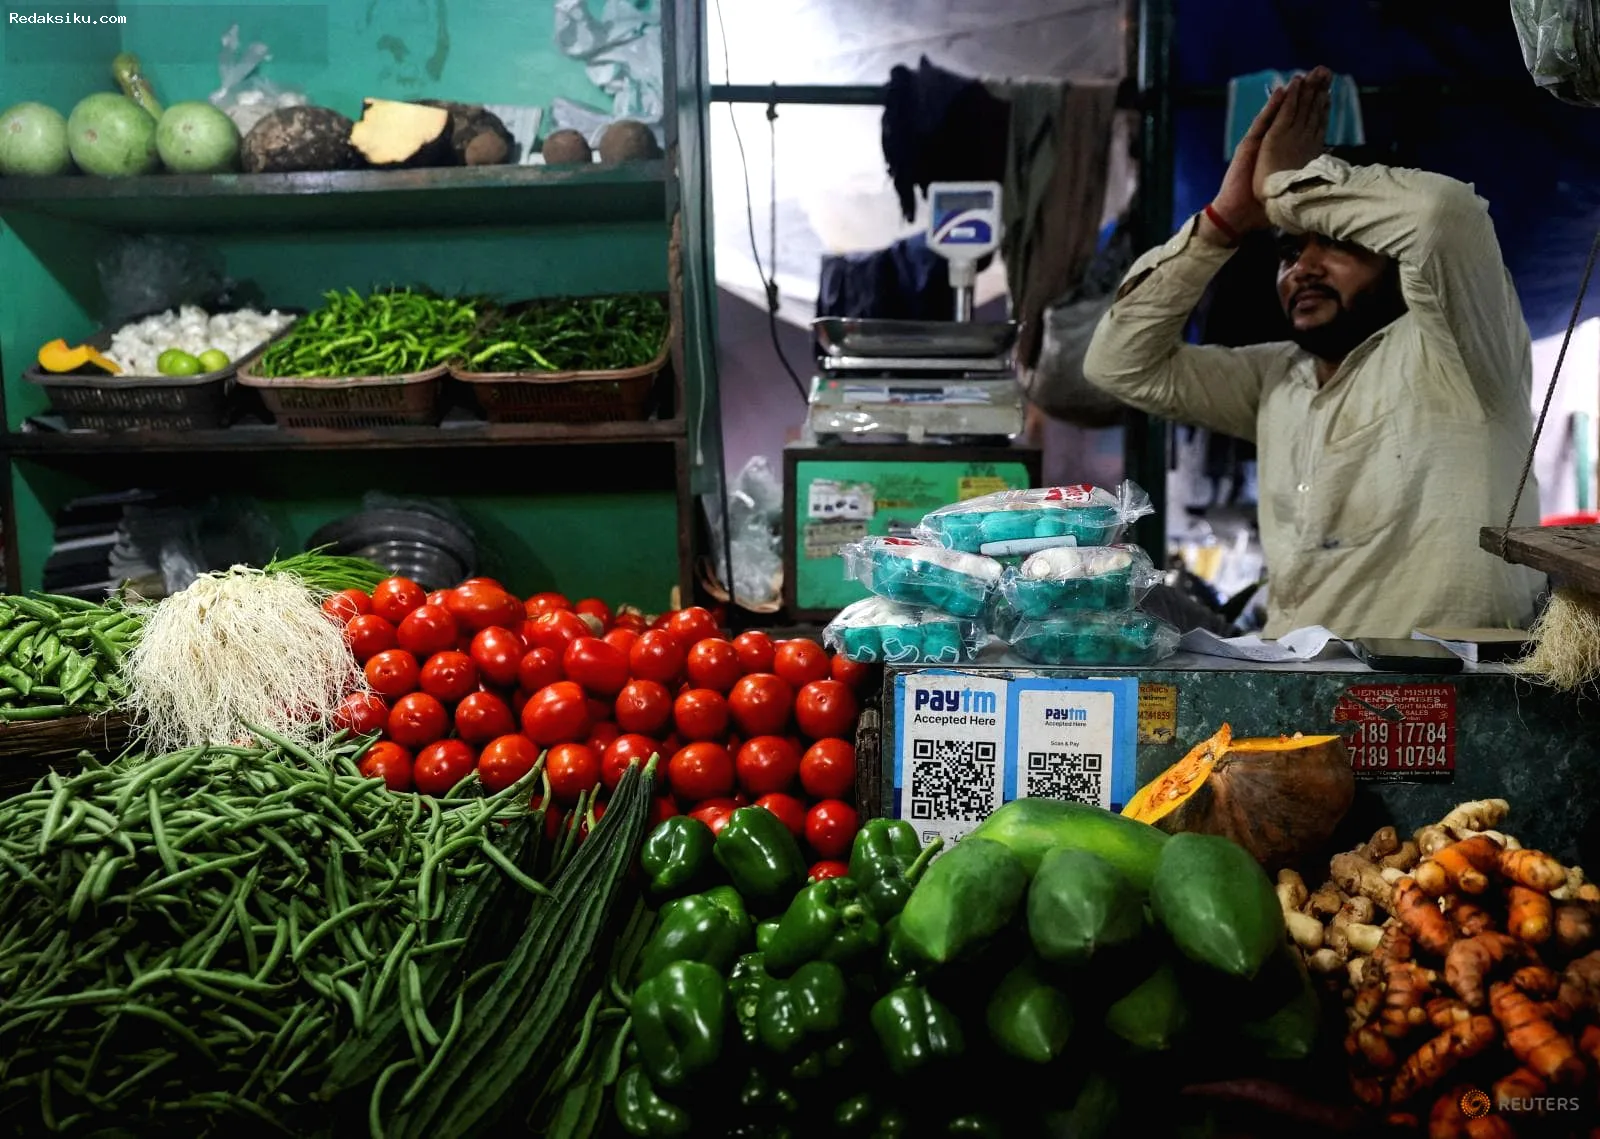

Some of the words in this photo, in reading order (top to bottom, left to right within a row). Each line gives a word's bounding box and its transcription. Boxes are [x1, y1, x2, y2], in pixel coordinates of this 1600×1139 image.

[1404, 688, 1449, 696] MISHRA
[914, 713, 967, 727] Accepted
[970, 715, 996, 726] Here
[1045, 720, 1072, 728] Accepted
[1397, 722, 1447, 744] 17784
[1347, 746, 1389, 767] 7189
[1395, 745, 1447, 767] 10794
